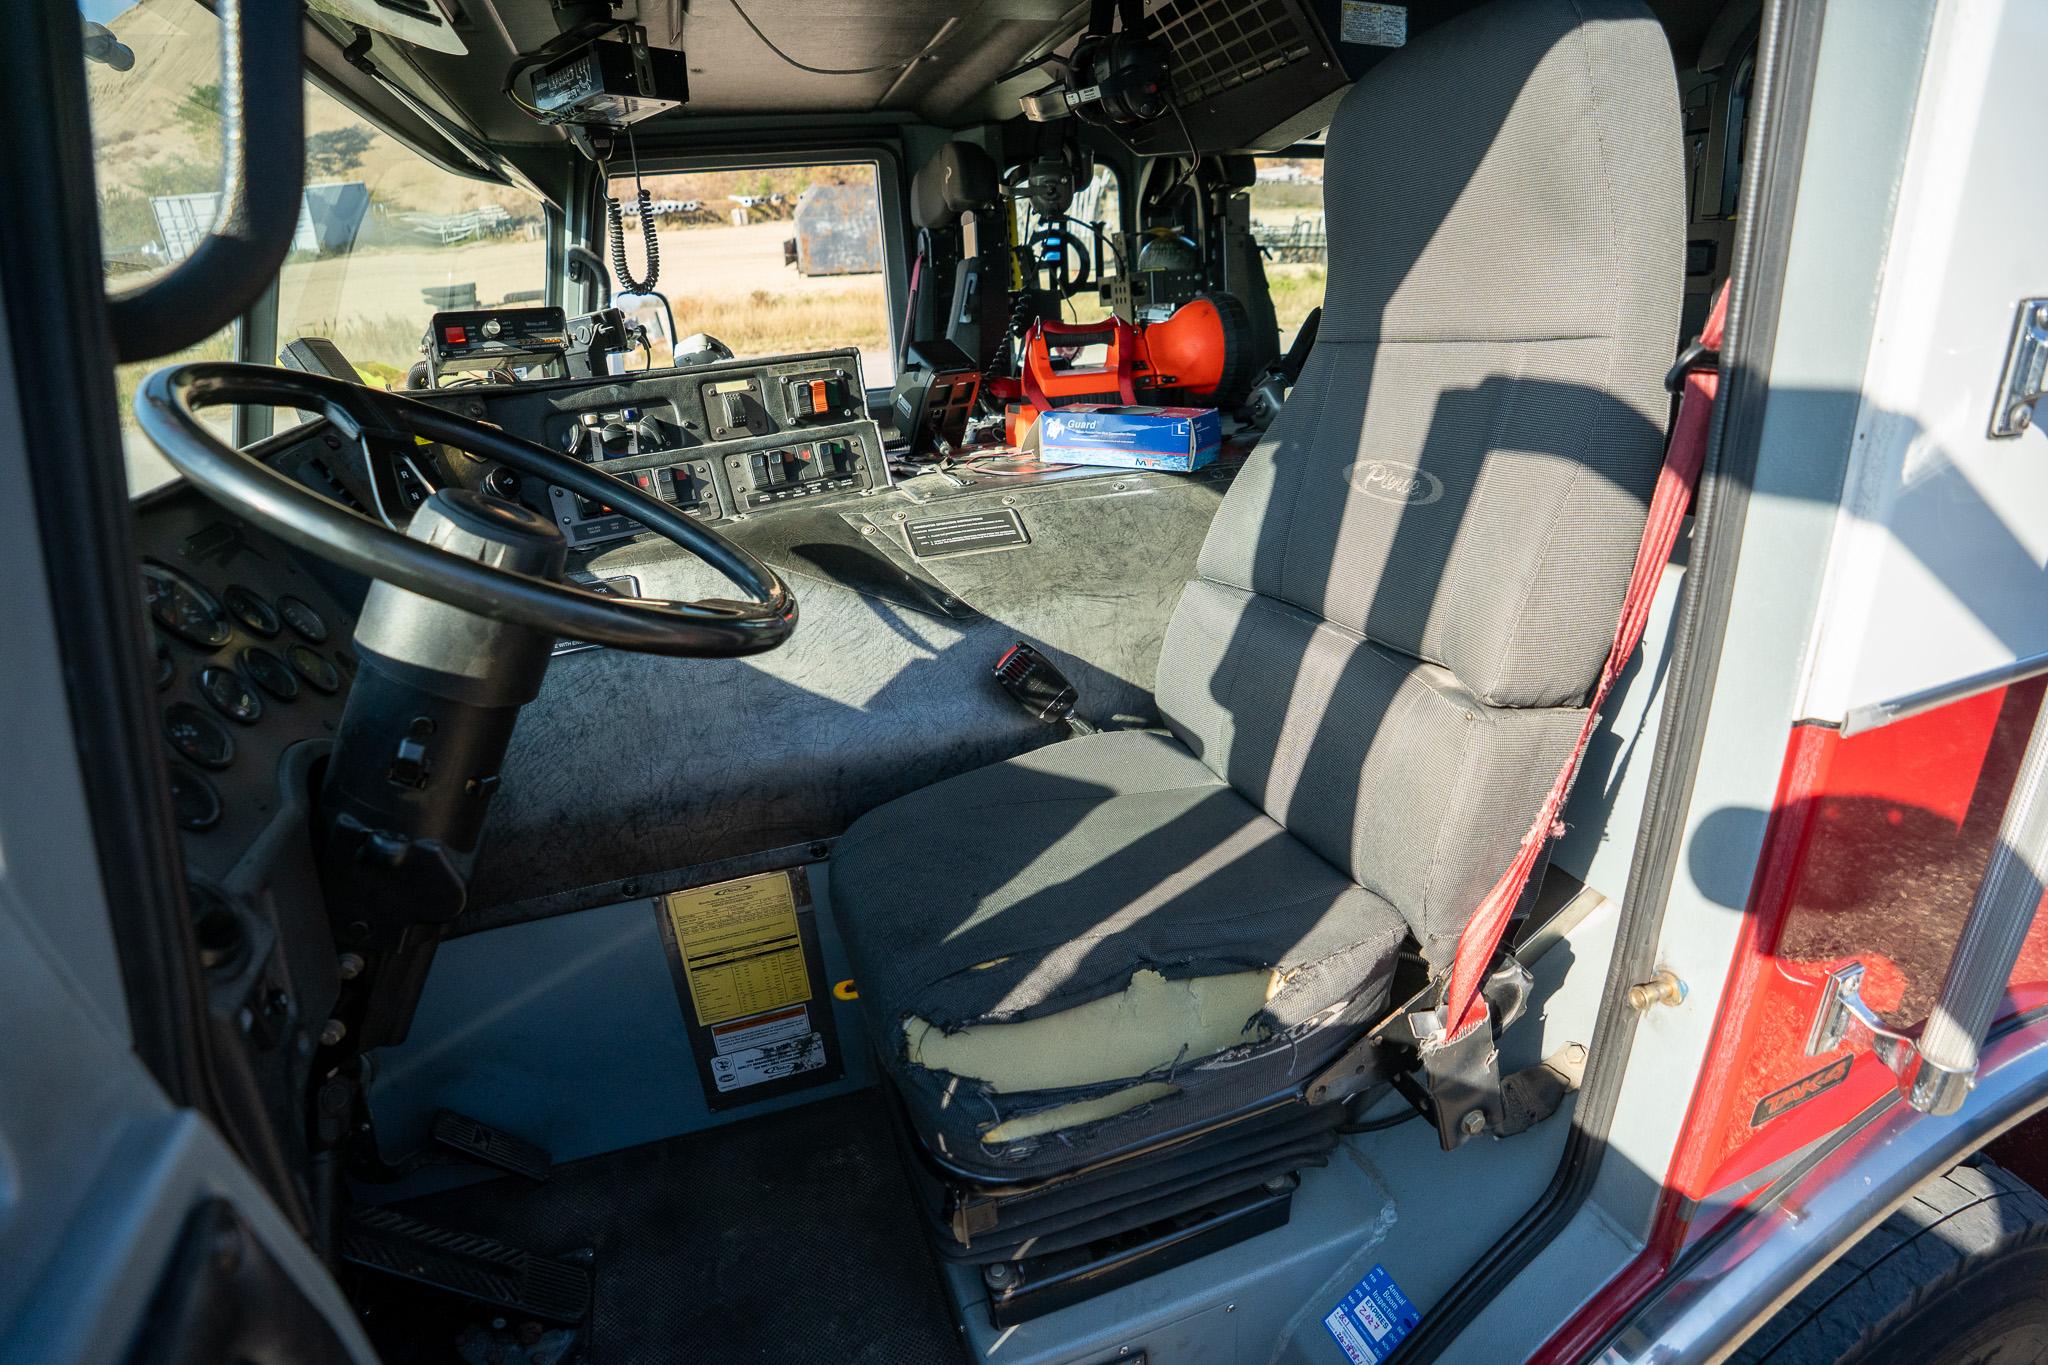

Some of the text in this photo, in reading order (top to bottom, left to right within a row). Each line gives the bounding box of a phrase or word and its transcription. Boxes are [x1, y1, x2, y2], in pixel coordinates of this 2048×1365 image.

[1067, 419, 1097, 429] Guard
[1177, 423, 1185, 435] L
[400, 470, 409, 479] R
[1383, 1290, 1398, 1310] Boom
[1388, 1284, 1407, 1305] Annual
[1365, 1299, 1389, 1330] EXPIRES
[1372, 1289, 1397, 1322] Inspection
